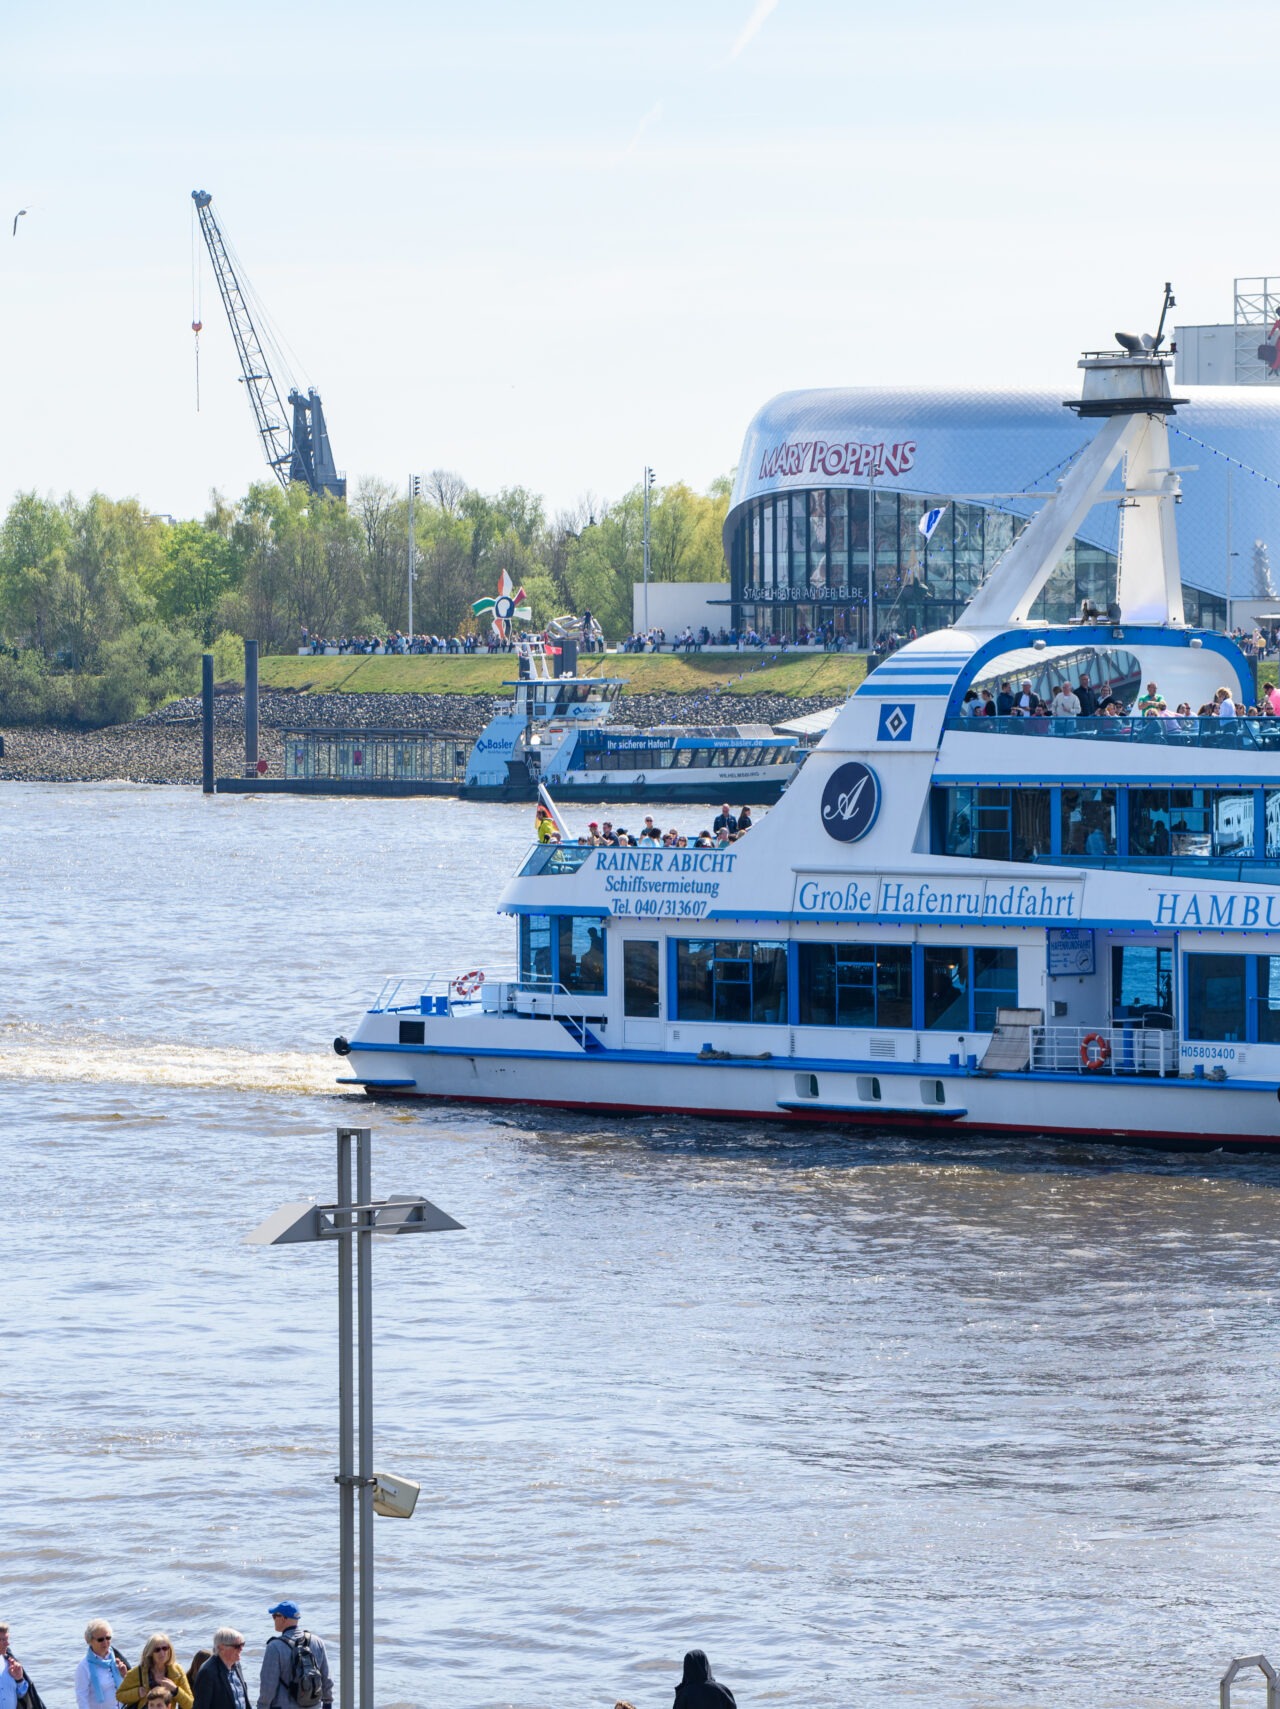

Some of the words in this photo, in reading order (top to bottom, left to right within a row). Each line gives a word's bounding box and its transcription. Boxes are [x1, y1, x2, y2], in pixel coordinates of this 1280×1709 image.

[758, 441, 811, 480] MARY
[809, 440, 917, 477] POPPINS
[743, 585, 766, 599] STAGE
[767, 586, 801, 600] THEATER
[803, 588, 816, 599] AN
[818, 587, 836, 599] DER
[838, 585, 863, 599] ELBE
[487, 738, 513, 750] Basler
[607, 739, 617, 749] Ihr
[619, 738, 647, 749] sicherer
[647, 738, 671, 749] Hafen!
[713, 738, 763, 748] www.basler.de
[595, 852, 663, 871] RAINER
[667, 853, 737, 873] ABICHT
[604, 874, 720, 899] Schiffsvermietung
[612, 898, 631, 914] Tel.
[634, 899, 707, 916] 040/313607
[799, 881, 871, 911] Große
[880, 882, 1075, 916] Hafenrundfahrt
